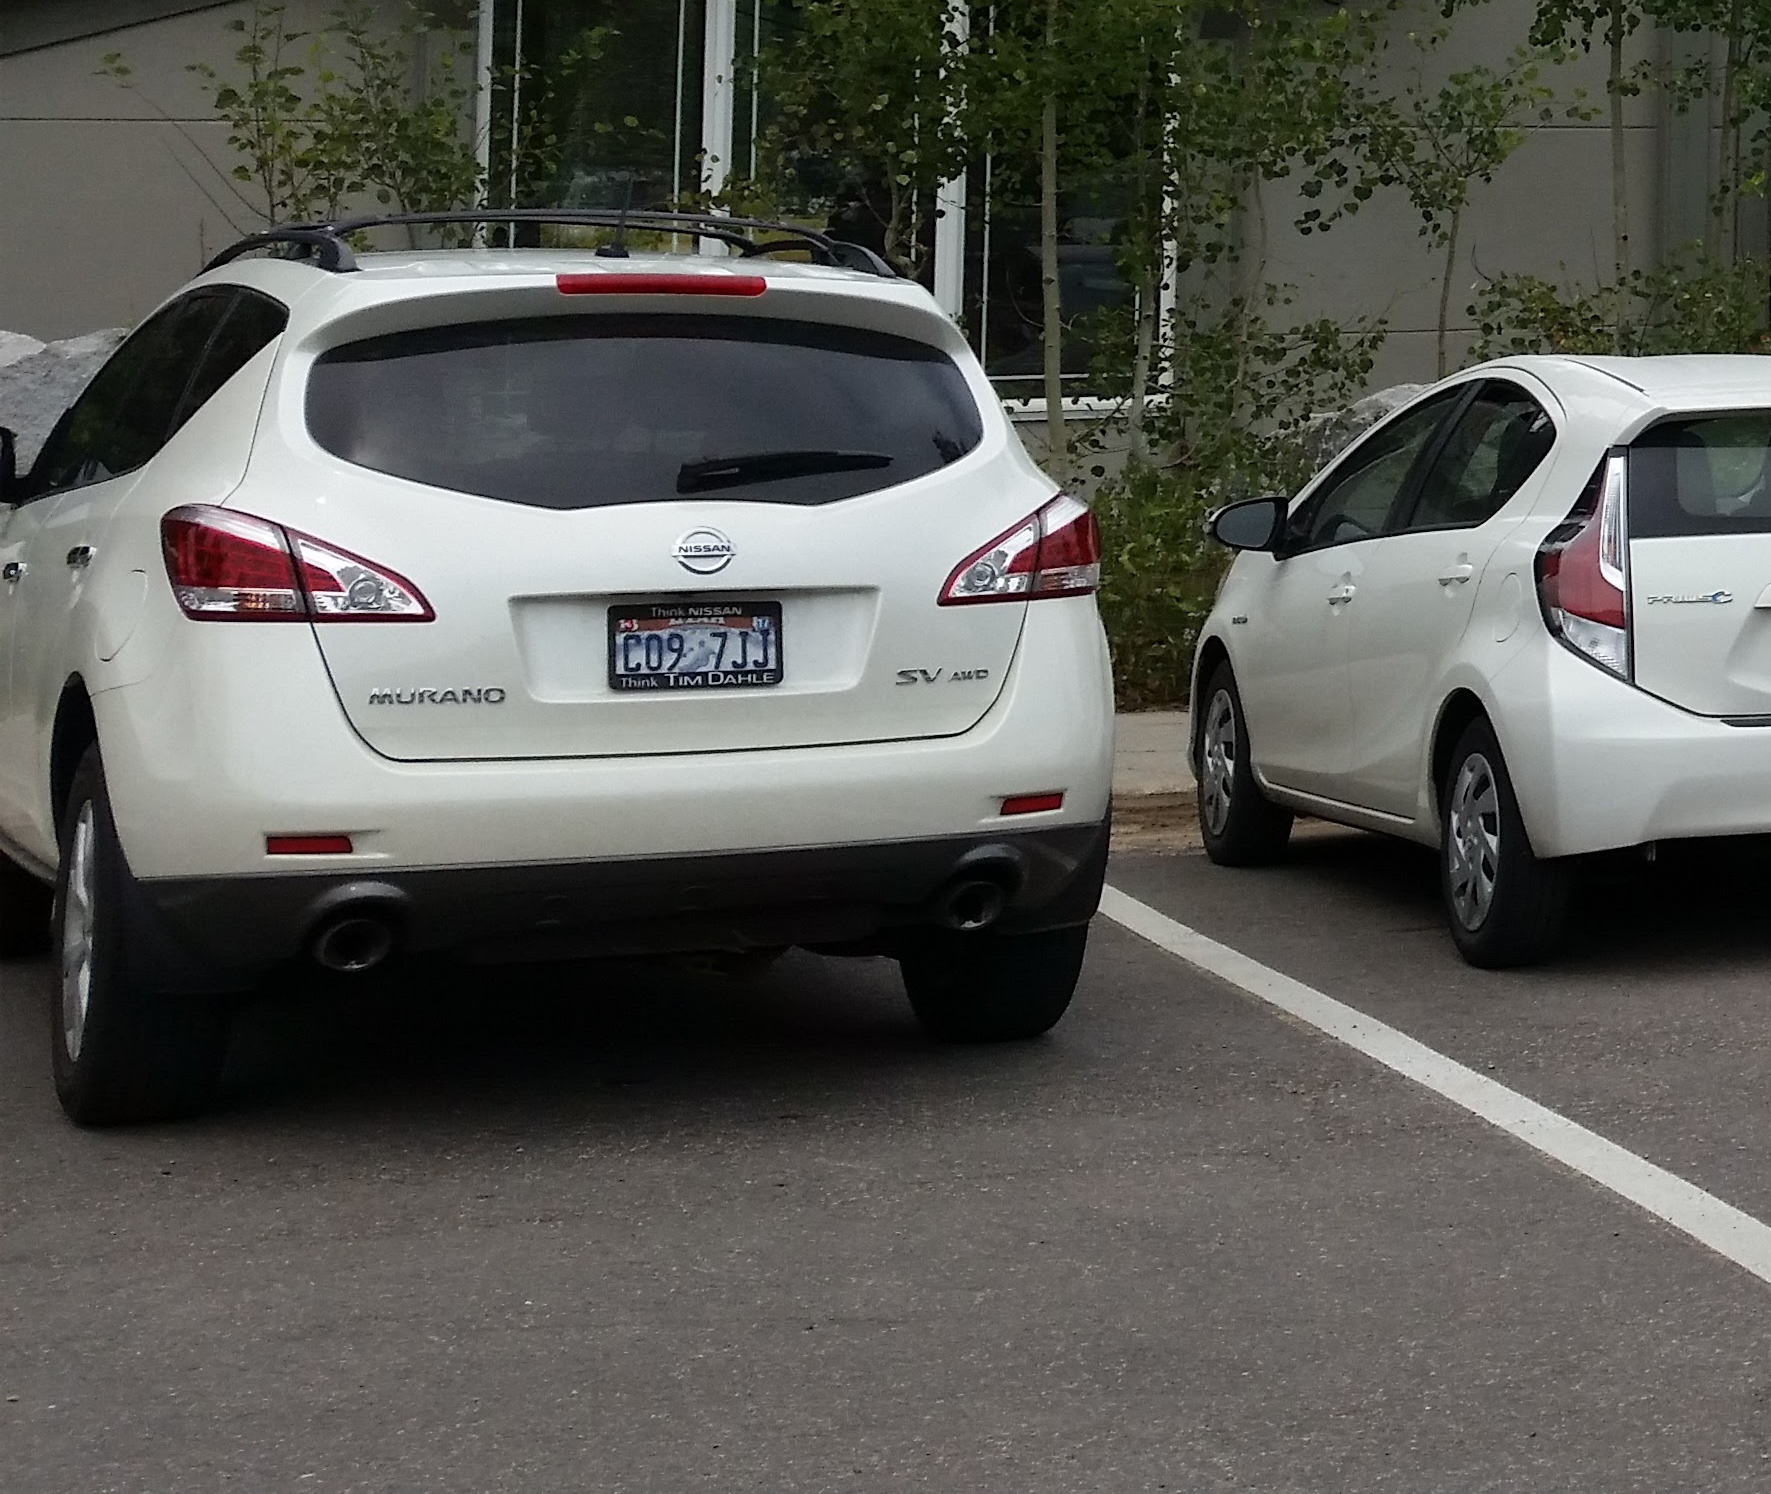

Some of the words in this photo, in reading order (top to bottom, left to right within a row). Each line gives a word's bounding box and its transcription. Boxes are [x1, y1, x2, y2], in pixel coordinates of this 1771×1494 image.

[678, 545, 731, 553] NISSAN
[650, 607, 687, 617] Think
[688, 606, 742, 616] NISSAN
[623, 633, 684, 673] C09
[709, 629, 770, 671] 7JJ
[620, 677, 658, 688] Think
[664, 673, 702, 687] TIM
[708, 671, 774, 686] DAHLE
[896, 667, 942, 685] SV
[948, 668, 989, 682] AWD
[369, 687, 506, 705] MURANO
